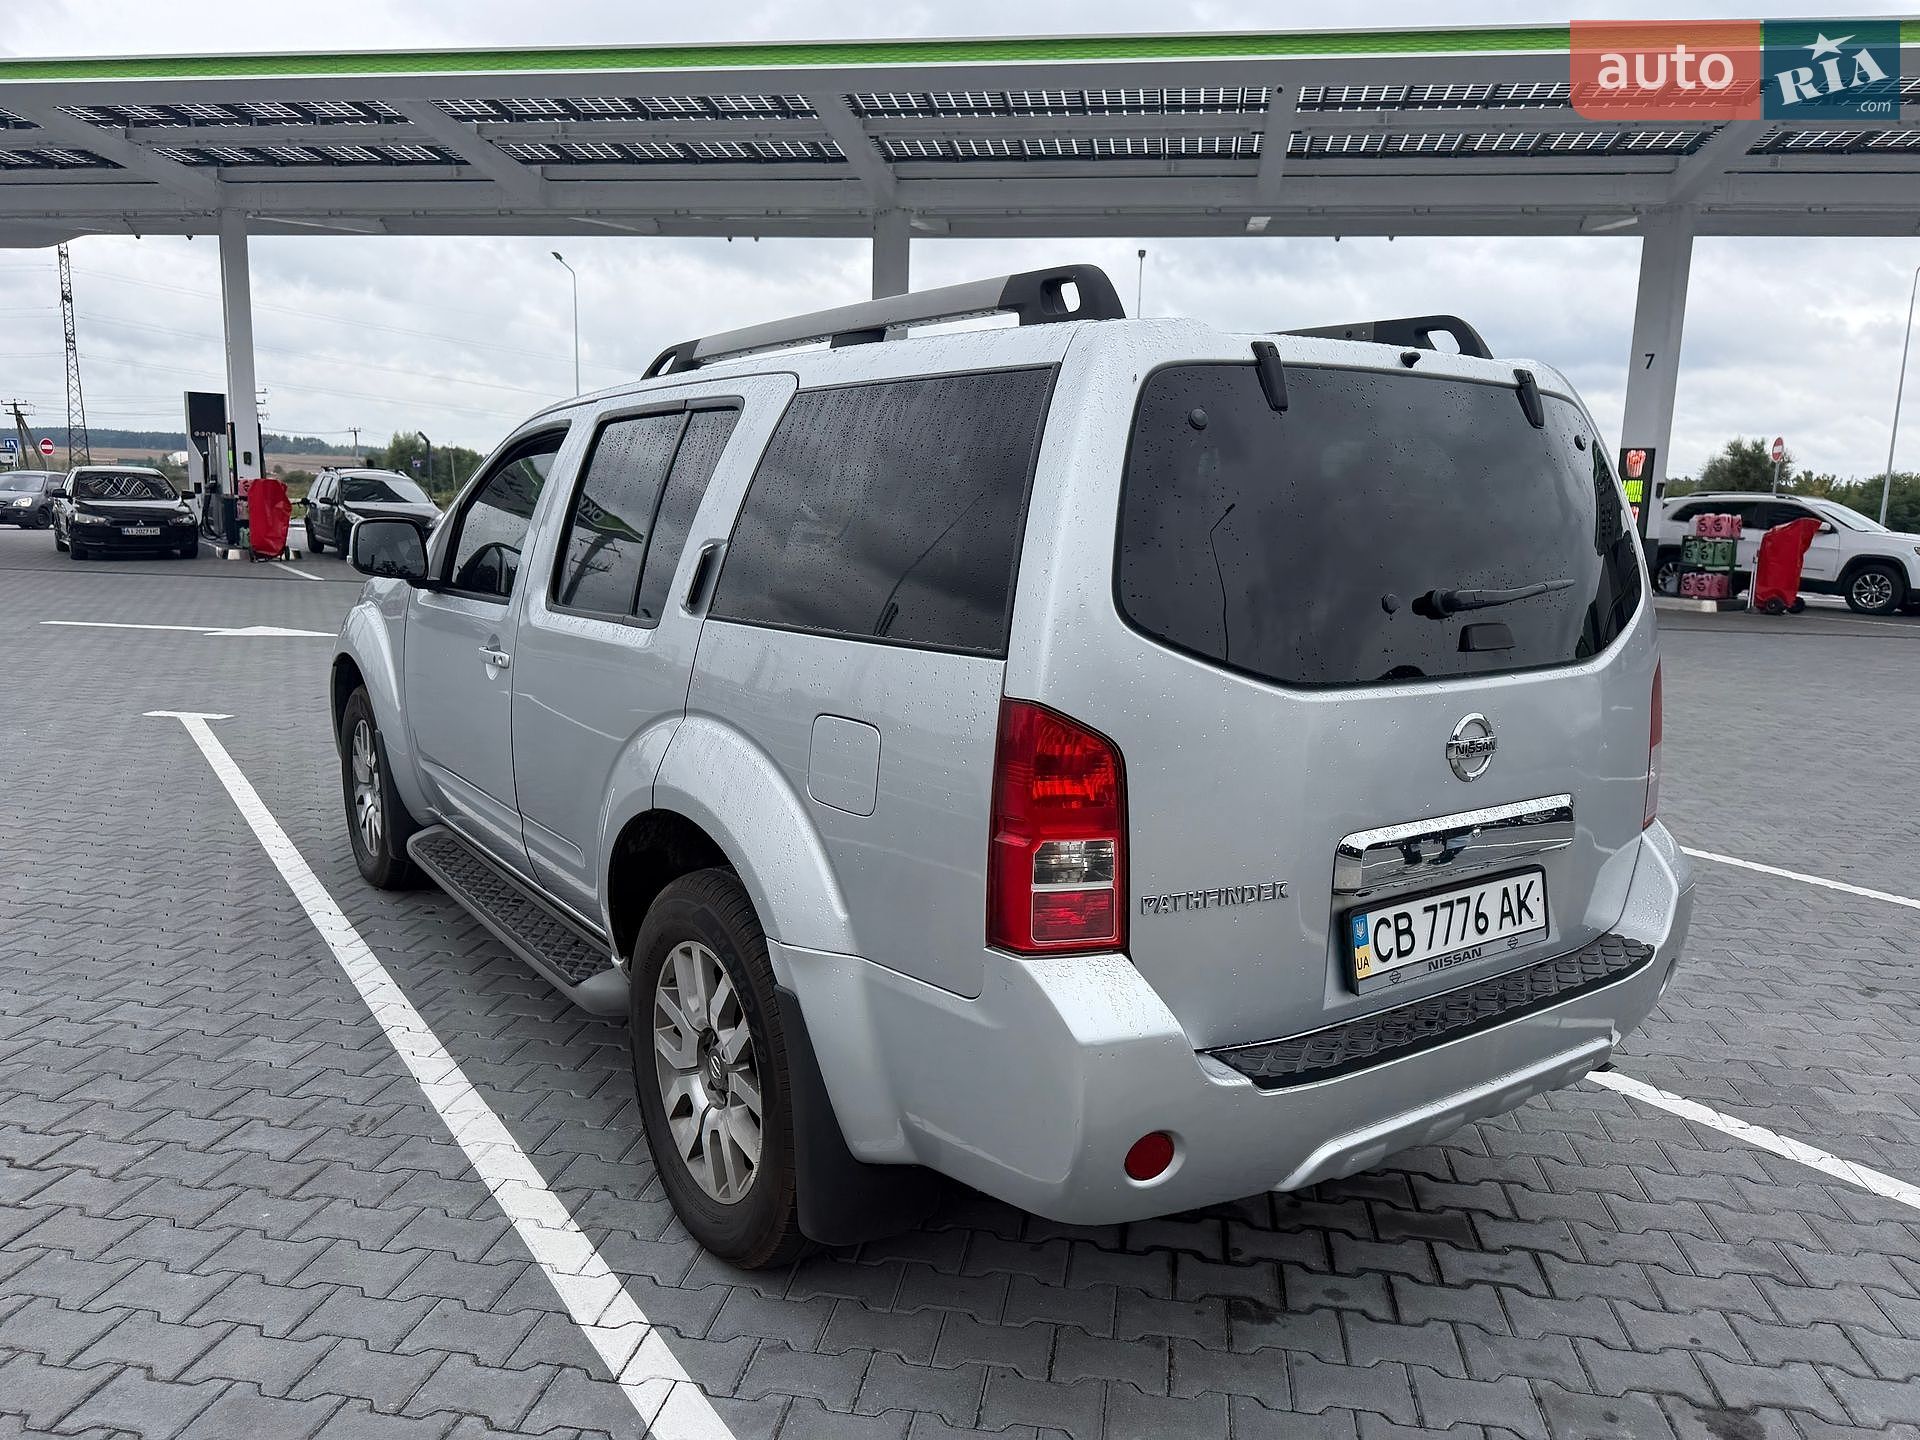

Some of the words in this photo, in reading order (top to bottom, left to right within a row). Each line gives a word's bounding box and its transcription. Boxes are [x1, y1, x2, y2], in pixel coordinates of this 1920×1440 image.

[1644, 352, 1656, 370] 7
[1455, 739, 1496, 755] NISSAN
[1140, 880, 1289, 916] PATHFINDER
[1372, 911, 1416, 963] CB
[1422, 891, 1490, 951] 7776
[1498, 880, 1535, 931] AK
[1356, 955, 1370, 971] UA
[1427, 947, 1483, 972] NISSAN
